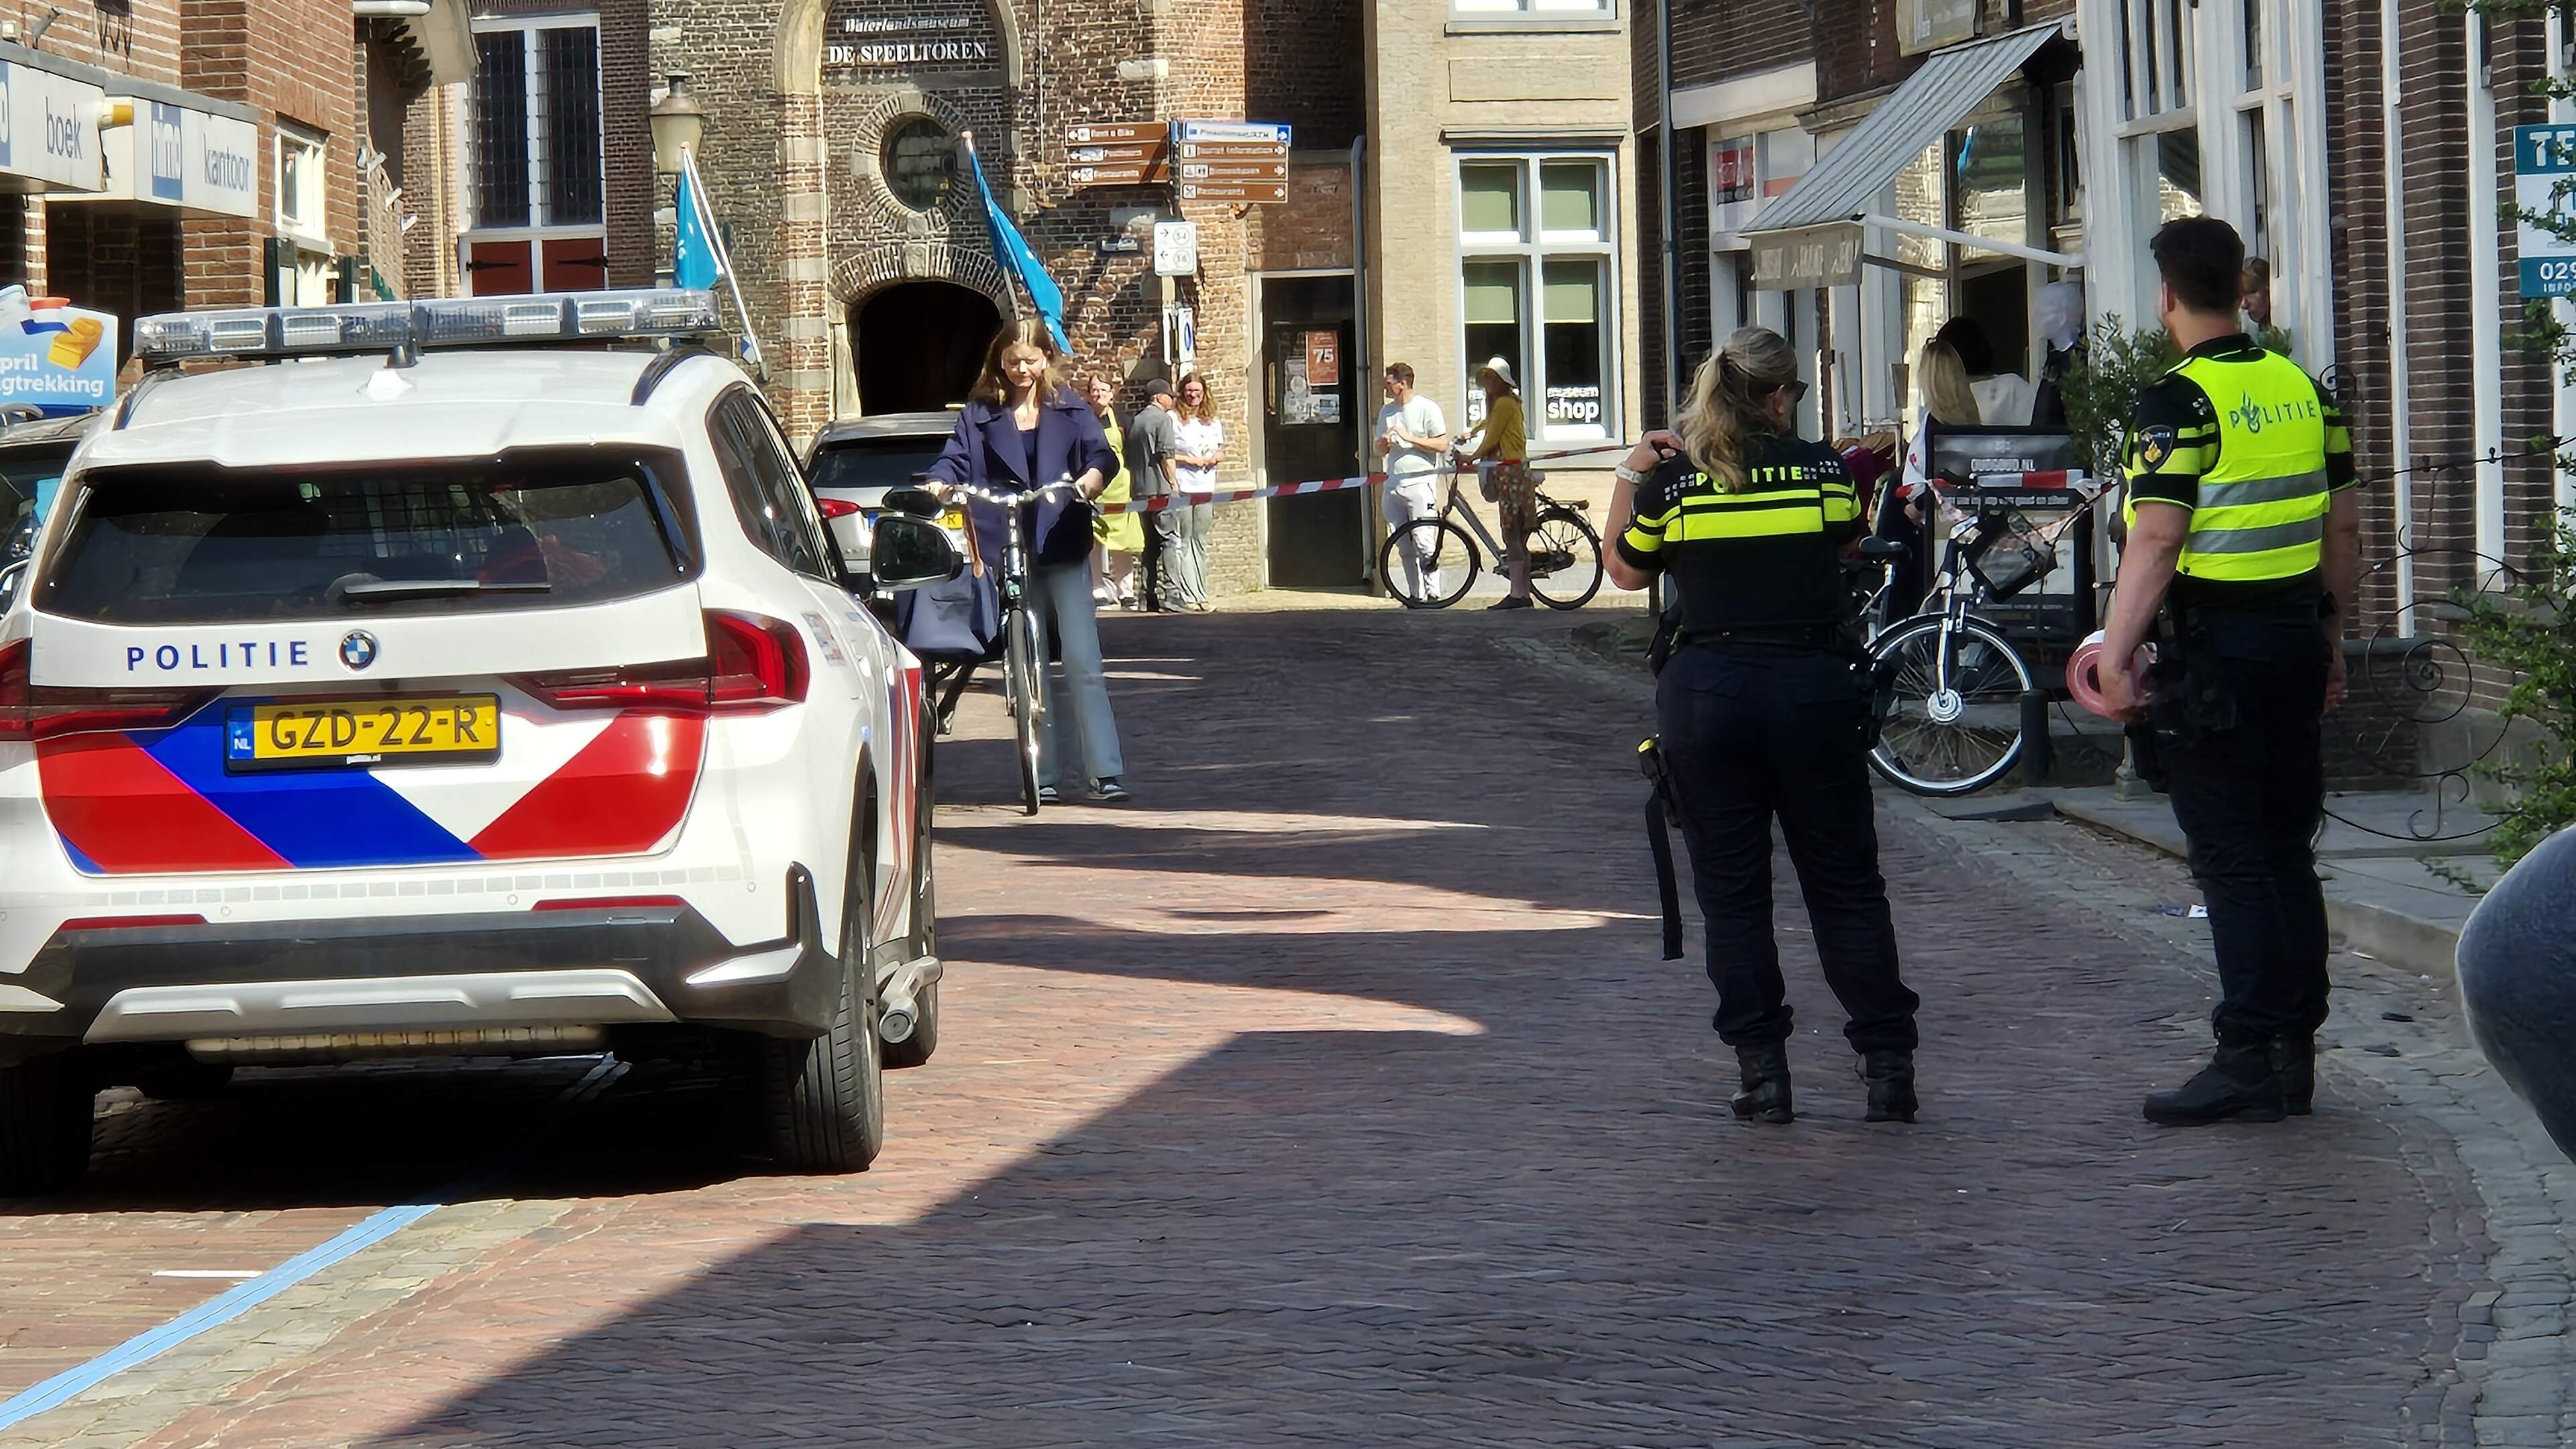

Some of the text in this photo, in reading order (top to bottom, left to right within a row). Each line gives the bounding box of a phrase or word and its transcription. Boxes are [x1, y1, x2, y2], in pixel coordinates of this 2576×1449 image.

[829, 42, 986, 64] DE SPEELTOREN
[45, 96, 83, 160] boek
[203, 133, 250, 193] kantoor
[0, 374, 104, 398] gtrekking
[1546, 398, 1600, 423] shop
[1696, 466, 1803, 494] POITIE
[126, 641, 309, 671] POLITIE
[270, 705, 479, 751] GZD-22-R
[233, 737, 251, 751] NL
